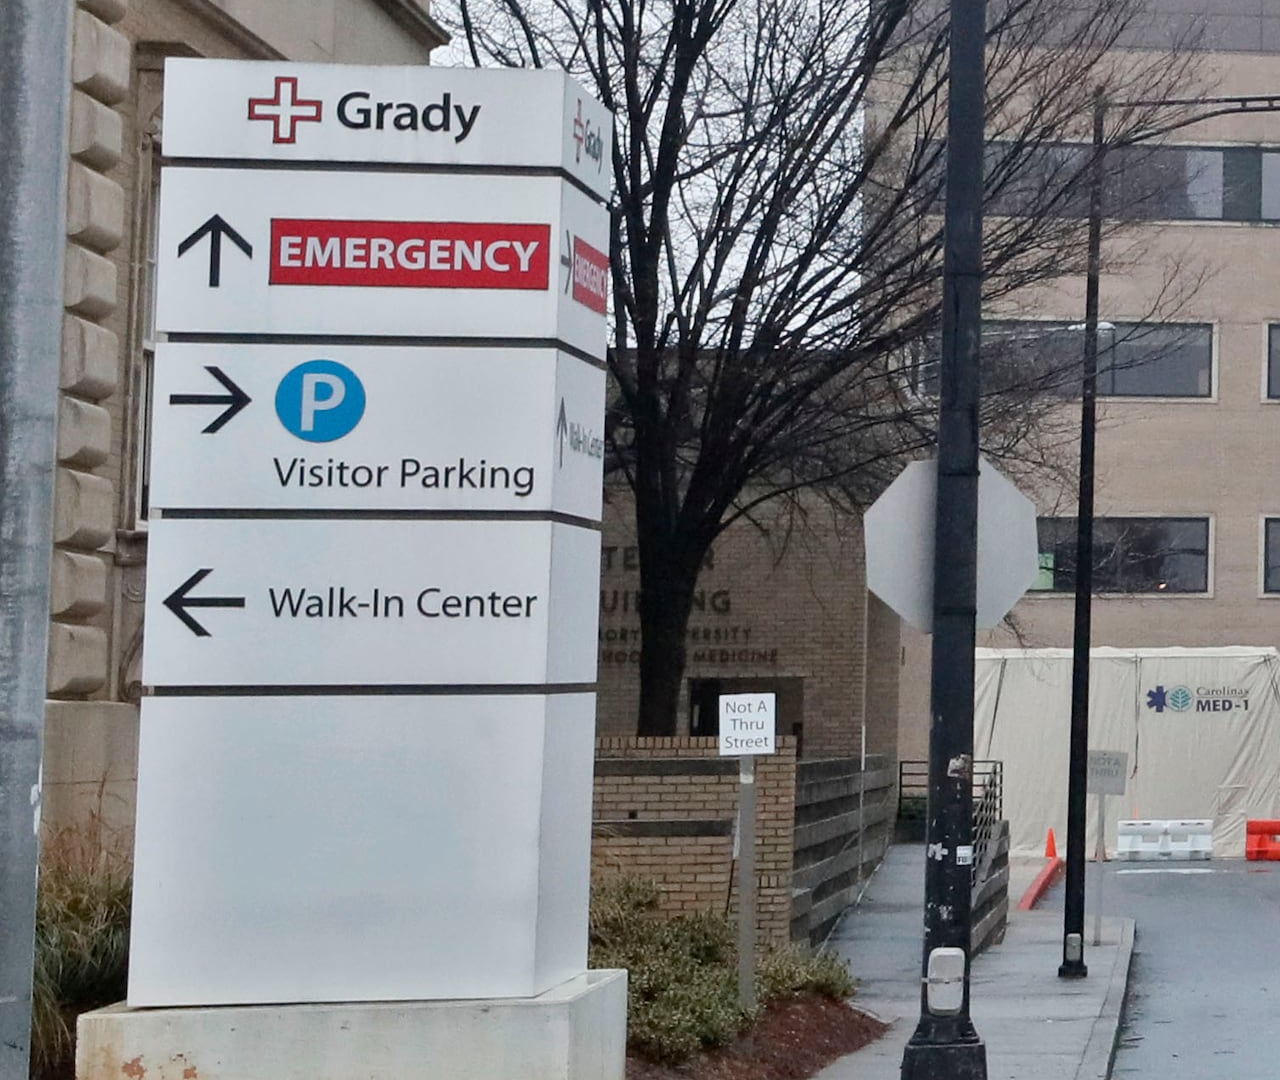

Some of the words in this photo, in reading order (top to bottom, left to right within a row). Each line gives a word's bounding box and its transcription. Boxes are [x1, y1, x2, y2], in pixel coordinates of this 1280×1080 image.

[336, 90, 480, 142] Grady
[278, 235, 540, 273] EMERGENCY
[300, 373, 345, 432] P
[273, 458, 388, 489] Visitor
[400, 458, 536, 497] Parking
[269, 586, 404, 618] Walk-In
[417, 587, 538, 617] Center
[725, 700, 752, 714] Not
[757, 699, 768, 713] A
[730, 718, 765, 731] Thru
[724, 735, 769, 750] Street
